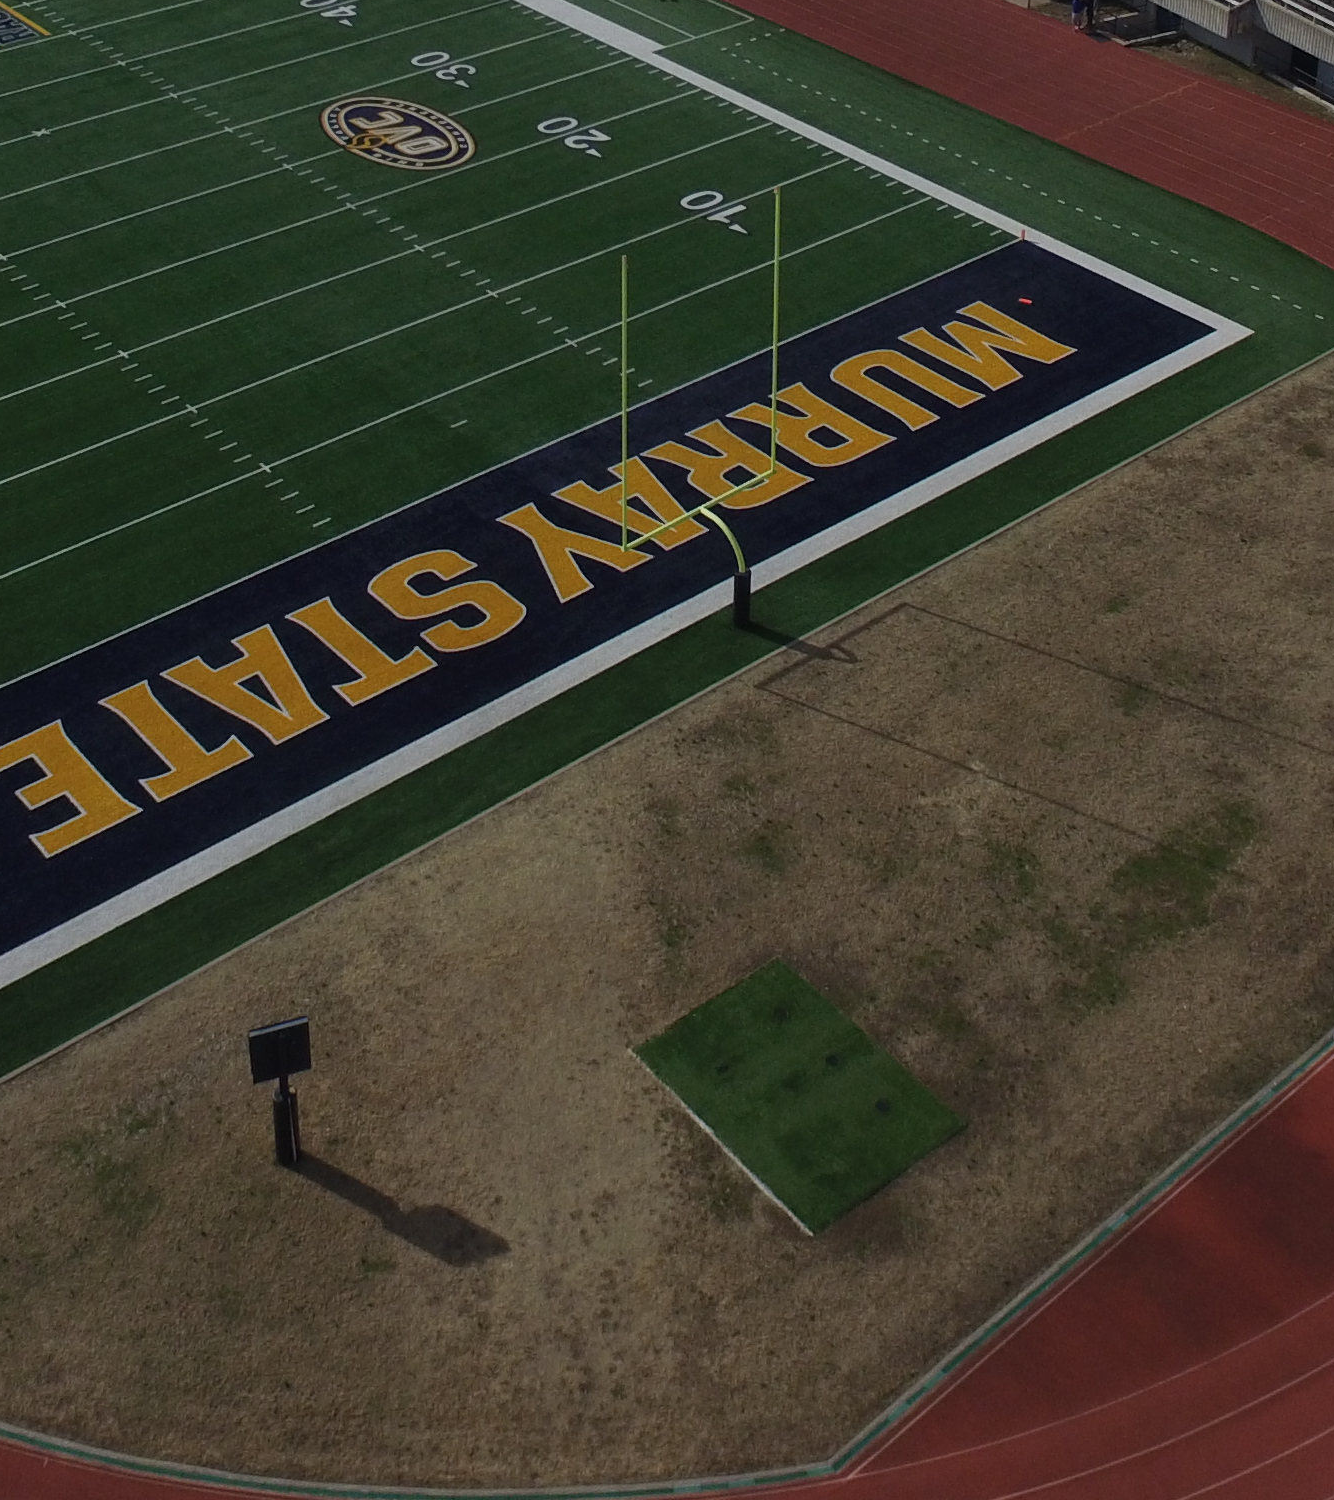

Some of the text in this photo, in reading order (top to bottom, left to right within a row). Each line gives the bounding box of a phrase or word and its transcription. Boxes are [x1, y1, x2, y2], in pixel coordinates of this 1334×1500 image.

[410, 51, 477, 81] 30
[348, 111, 449, 156] OVC
[536, 116, 612, 150] 20
[679, 190, 747, 224] 10
[495, 300, 1078, 604] MURRAY
